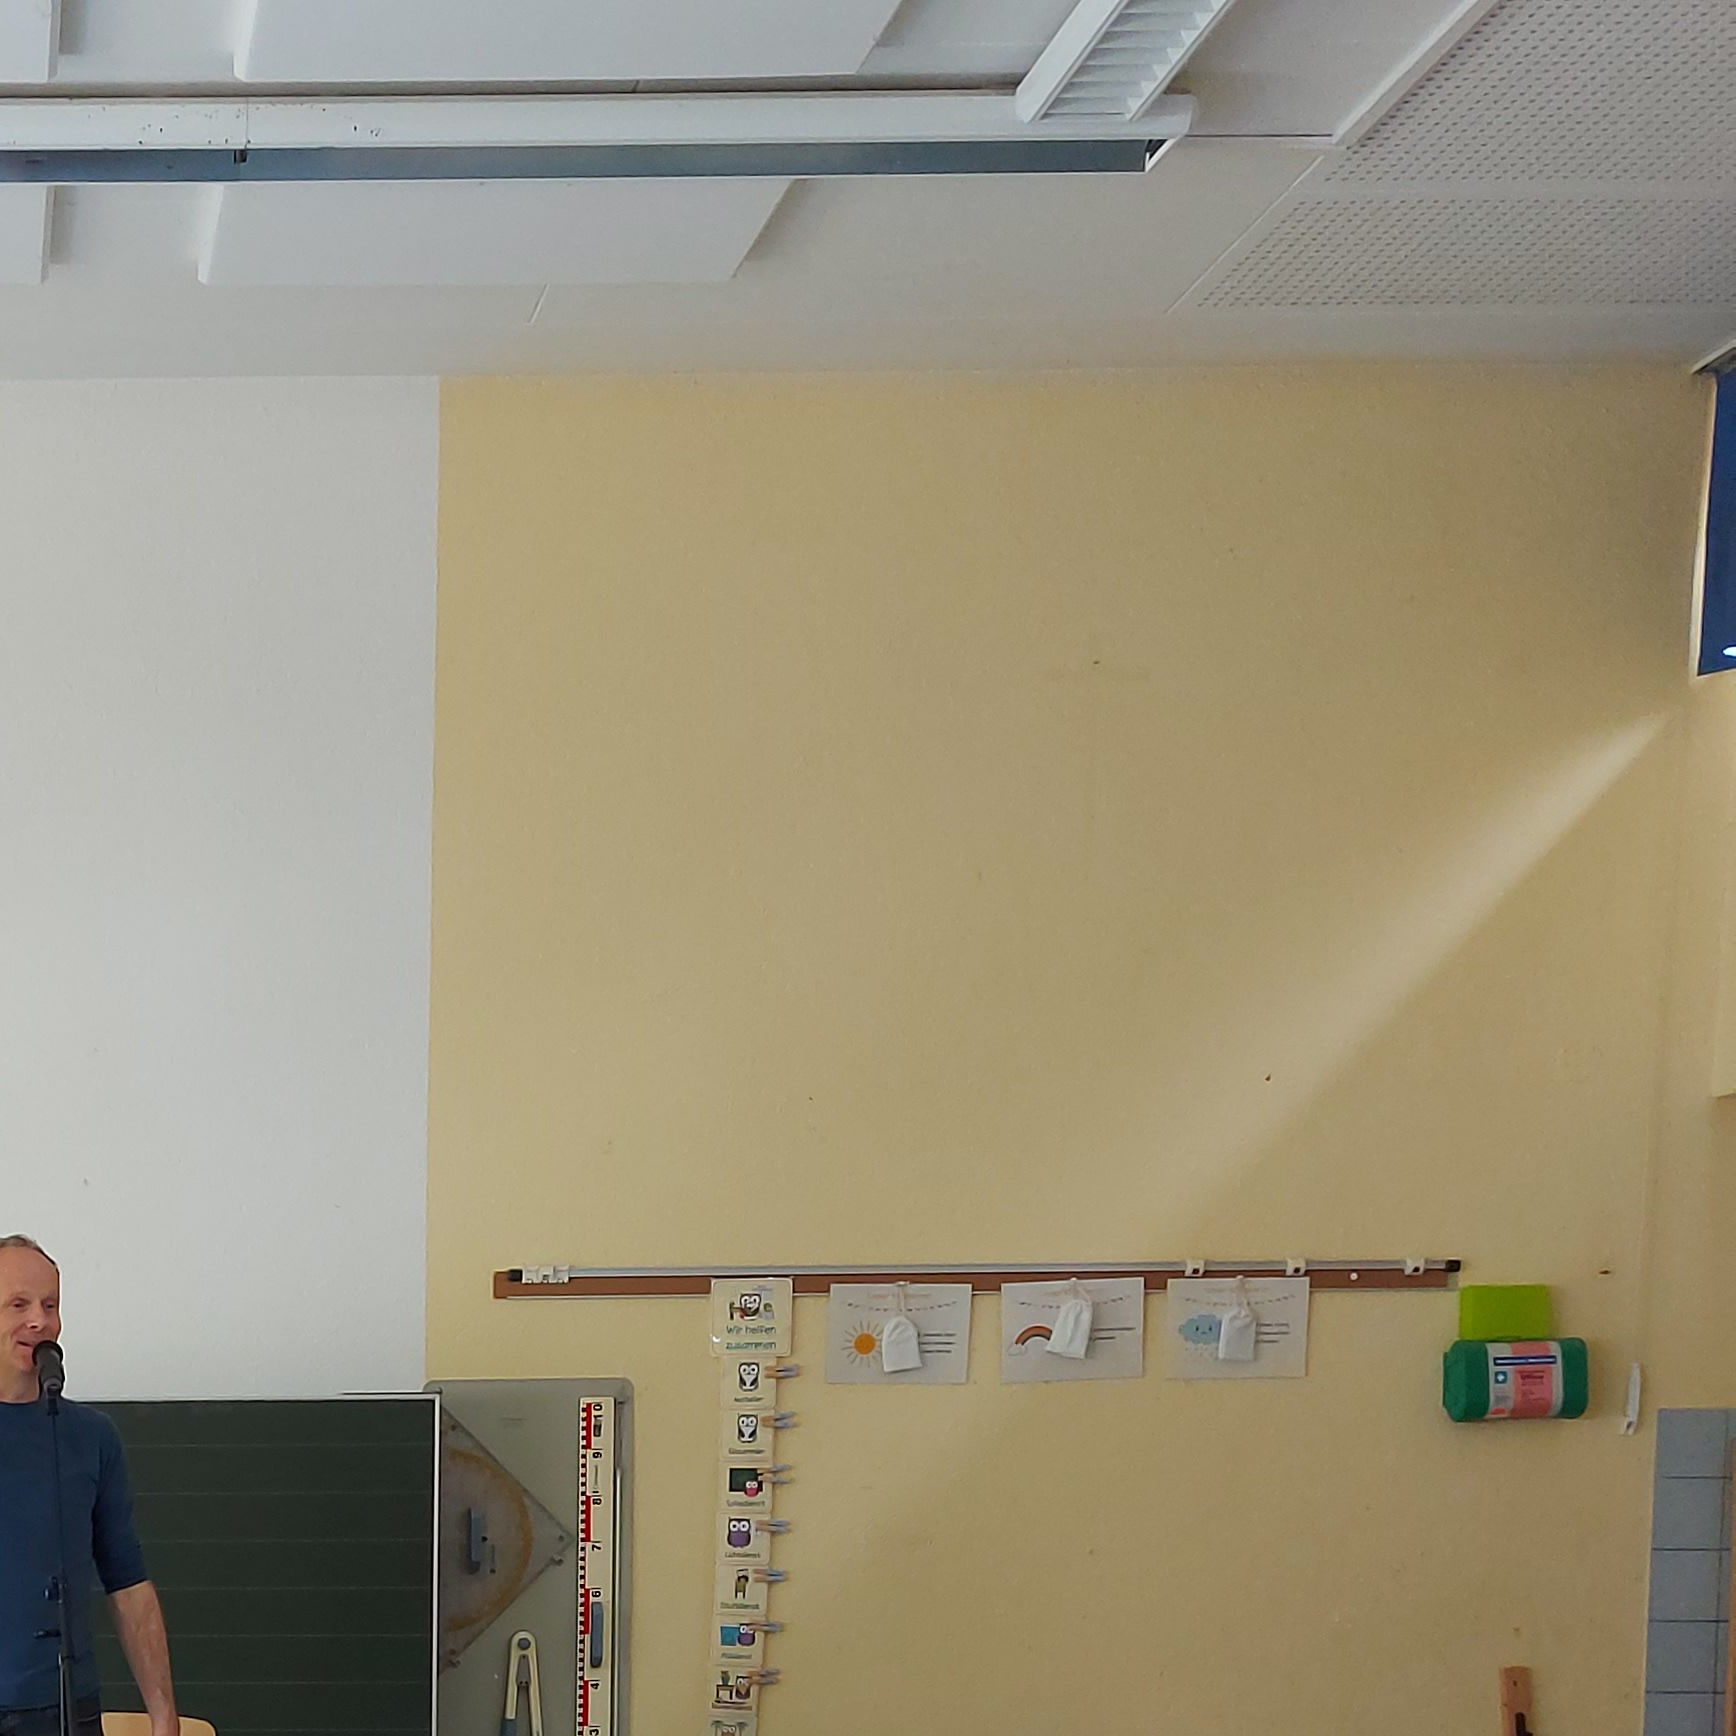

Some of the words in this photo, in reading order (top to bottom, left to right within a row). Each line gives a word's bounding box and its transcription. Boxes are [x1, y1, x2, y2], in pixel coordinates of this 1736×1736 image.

[593, 1404, 603, 1420] 10
[593, 1451, 602, 1459] 9
[593, 1498, 602, 1506] 8
[592, 1544, 602, 1552] 7
[592, 1590, 602, 1598] 6
[590, 1682, 600, 1690] 4
[590, 1728, 600, 1736] 3
